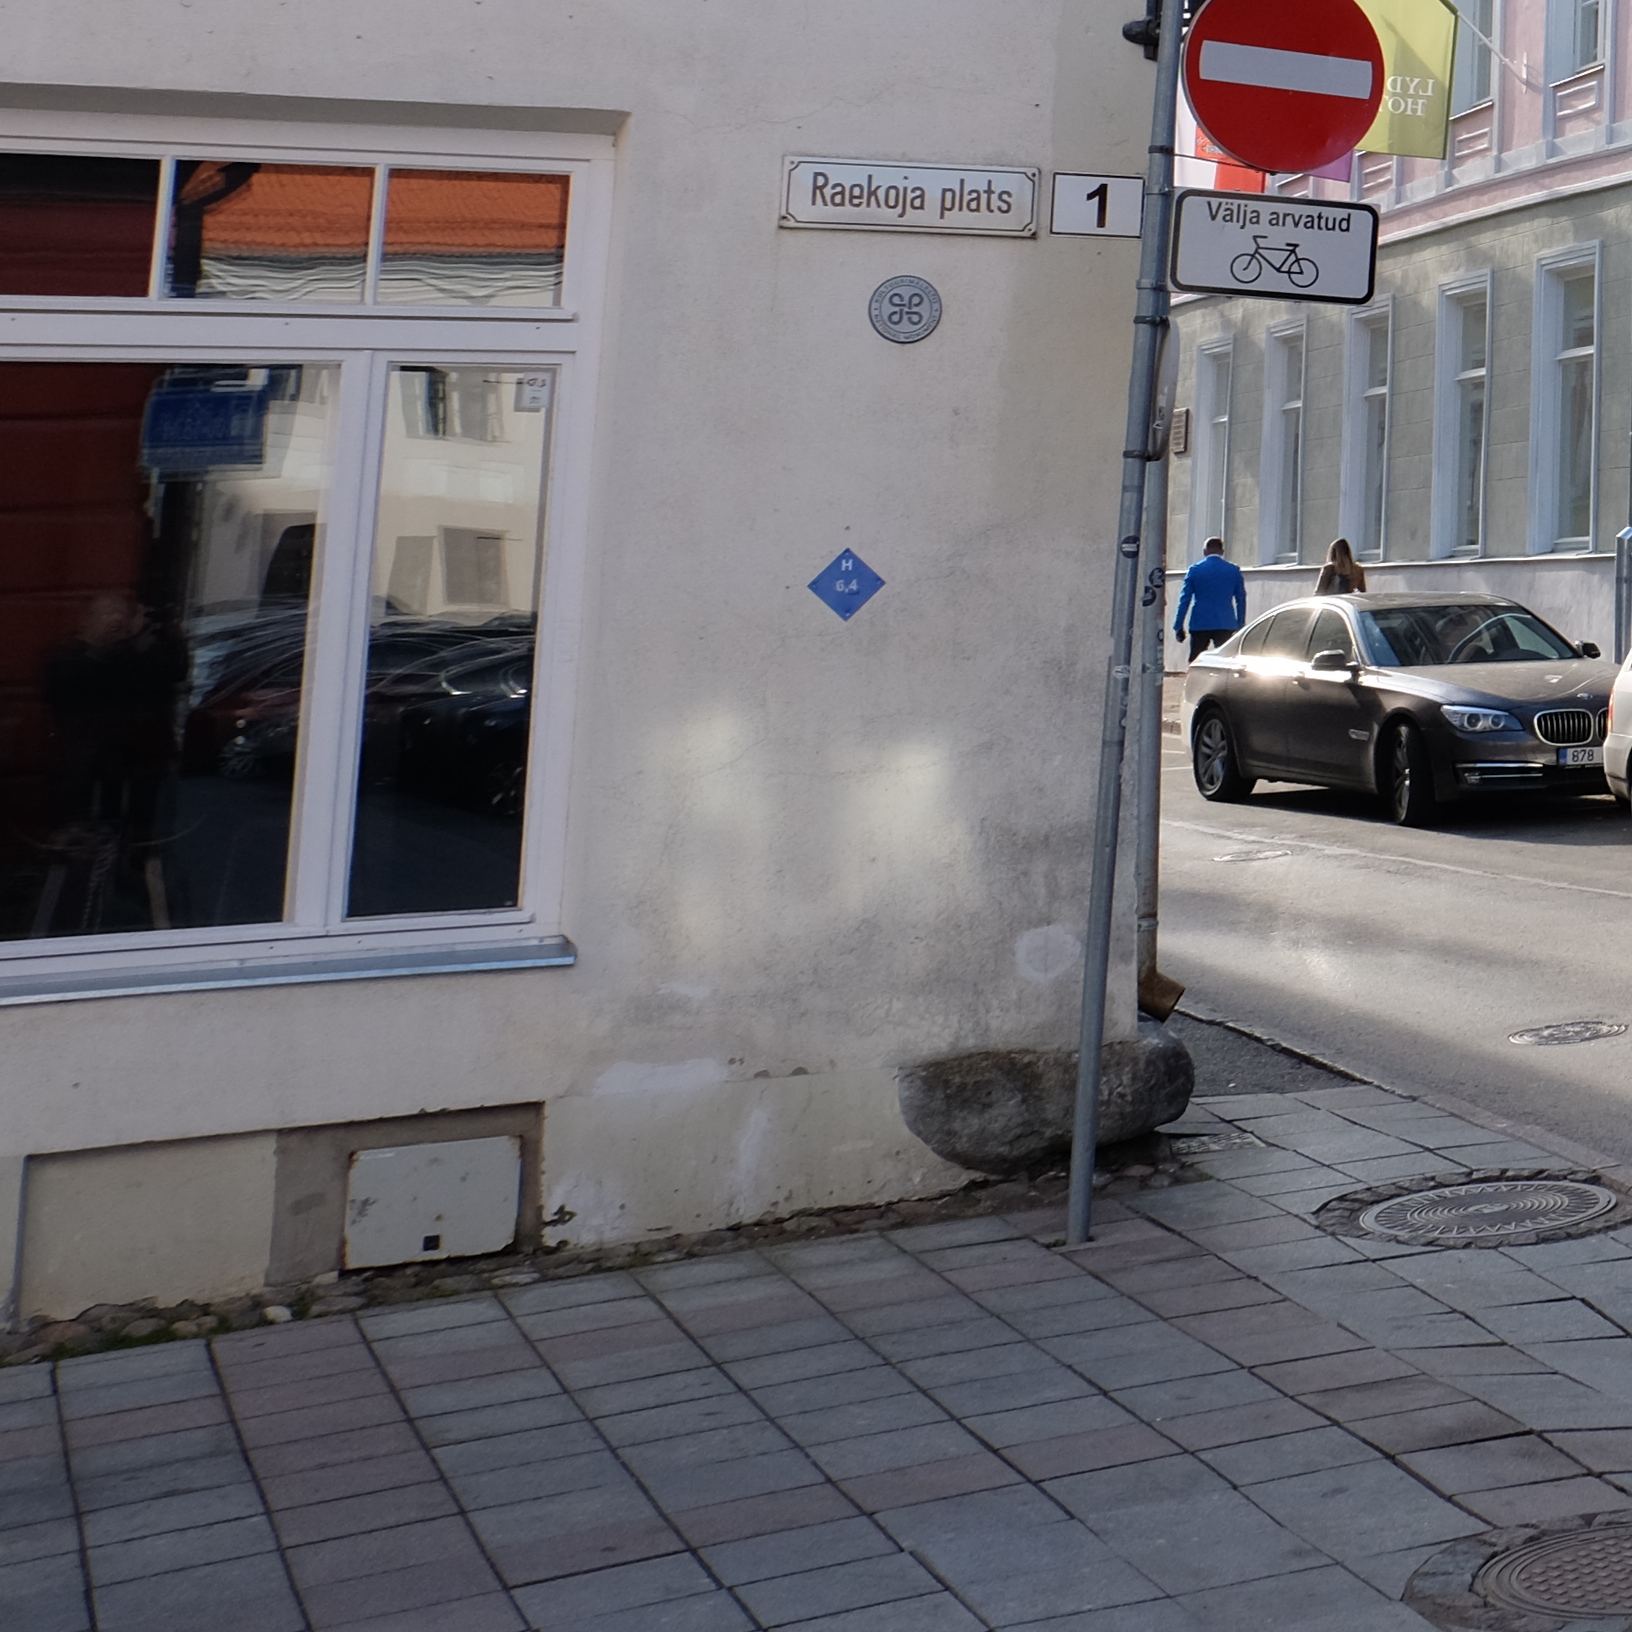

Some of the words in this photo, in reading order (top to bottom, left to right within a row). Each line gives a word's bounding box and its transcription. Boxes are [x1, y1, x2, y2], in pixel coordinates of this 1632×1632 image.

[810, 171, 927, 219] Raekoja
[939, 178, 1014, 220] plats
[1085, 183, 1110, 229] 1
[1206, 200, 1261, 230] Välja
[1268, 210, 1352, 233] arvatud
[841, 558, 853, 571] H
[835, 579, 858, 593] 6,4
[1572, 750, 1594, 762] 878
